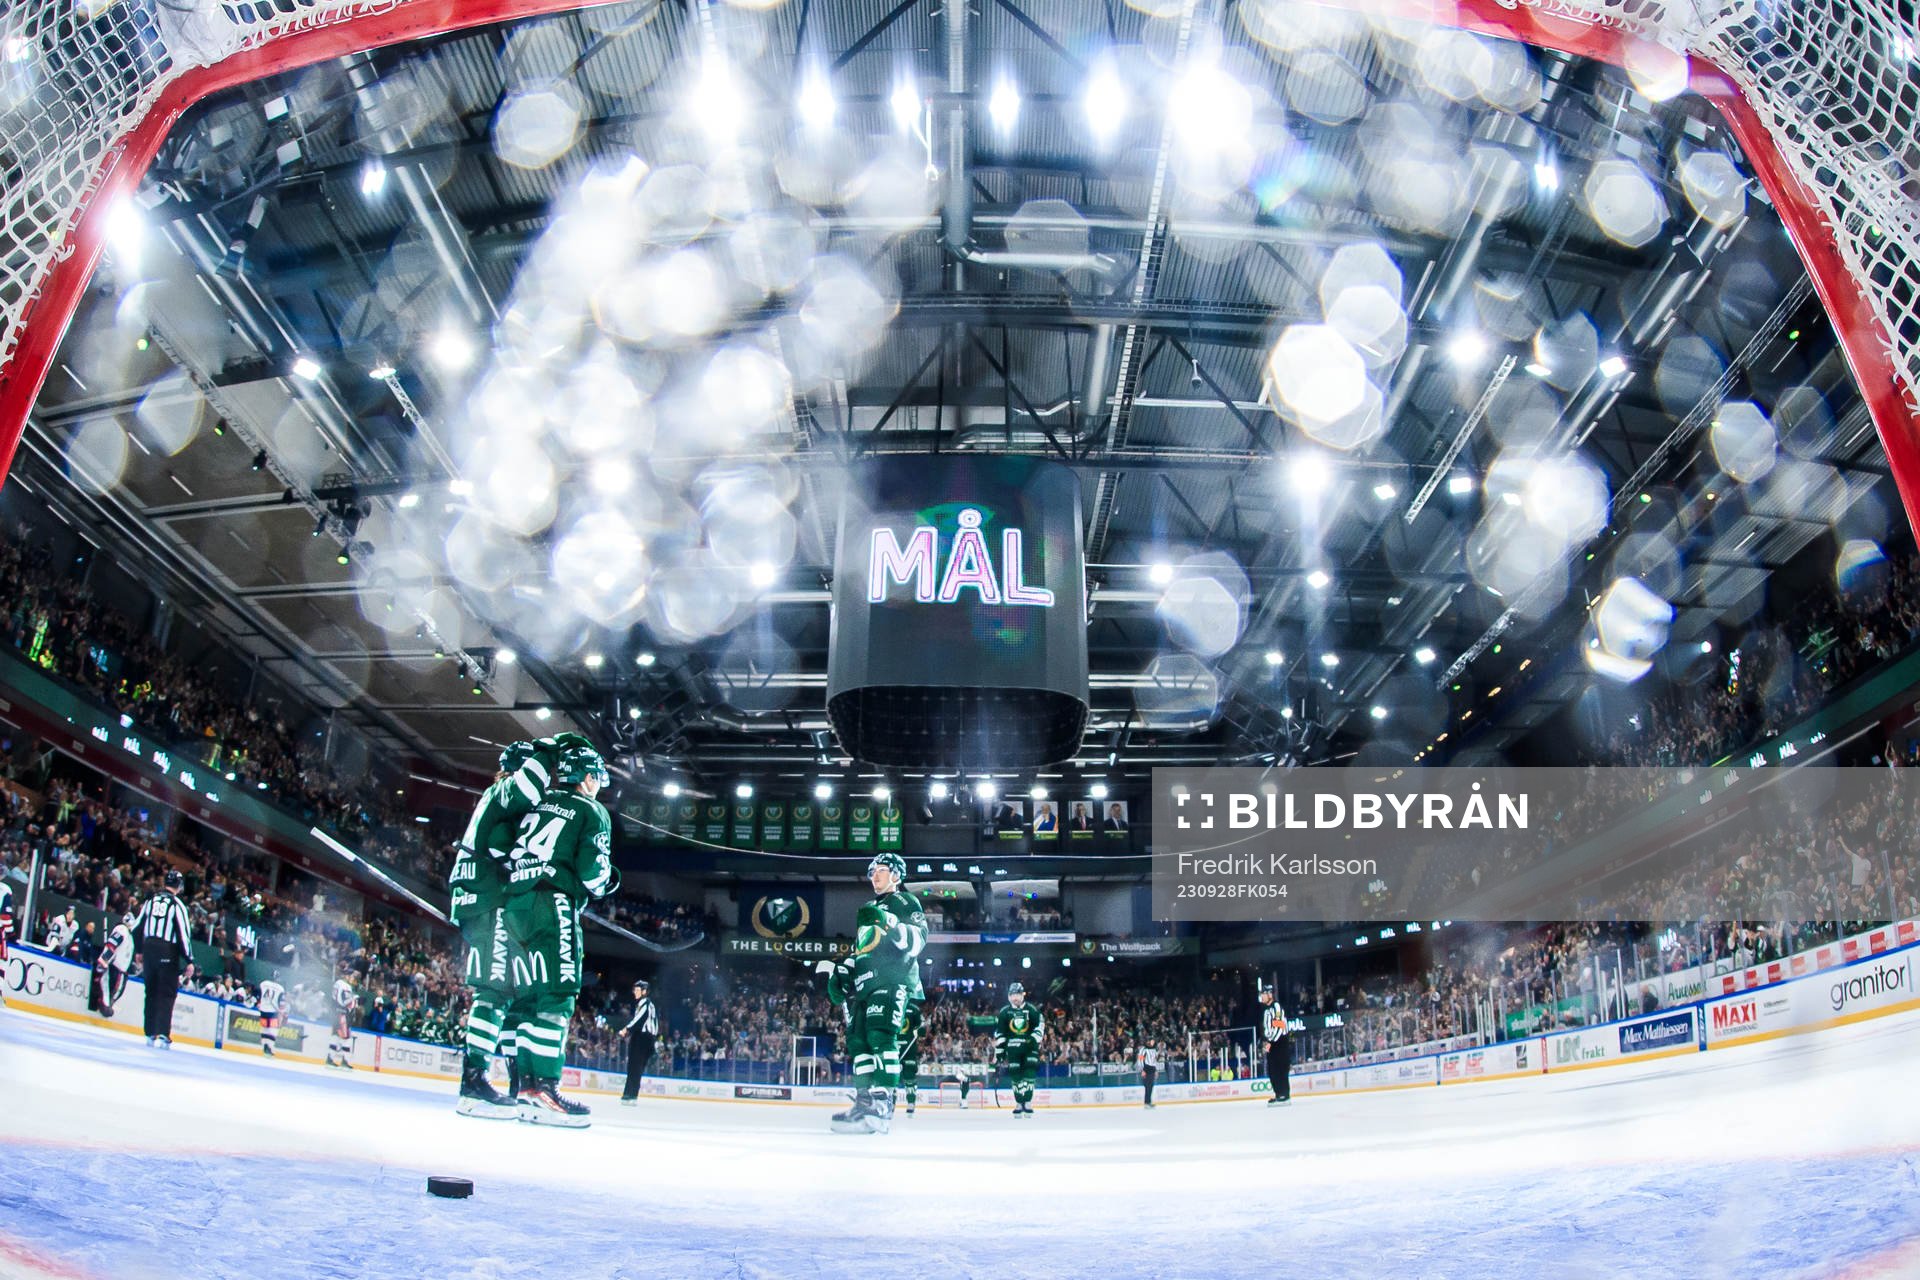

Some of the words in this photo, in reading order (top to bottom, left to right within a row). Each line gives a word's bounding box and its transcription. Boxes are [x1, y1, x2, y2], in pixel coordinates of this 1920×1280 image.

[867, 508, 1055, 607] MÅL
[553, 892, 576, 983] KLARAVIK
[731, 940, 759, 950] THE
[1101, 943, 1118, 952] The
[1120, 943, 1161, 953] Wolfpack
[1830, 964, 1906, 1011] granitor
[1712, 1003, 1757, 1029] MAXI
[1623, 1028, 1643, 1045] Max
[1643, 1021, 1689, 1041] Matthiessen
[1582, 1046, 1605, 1060] frakt
